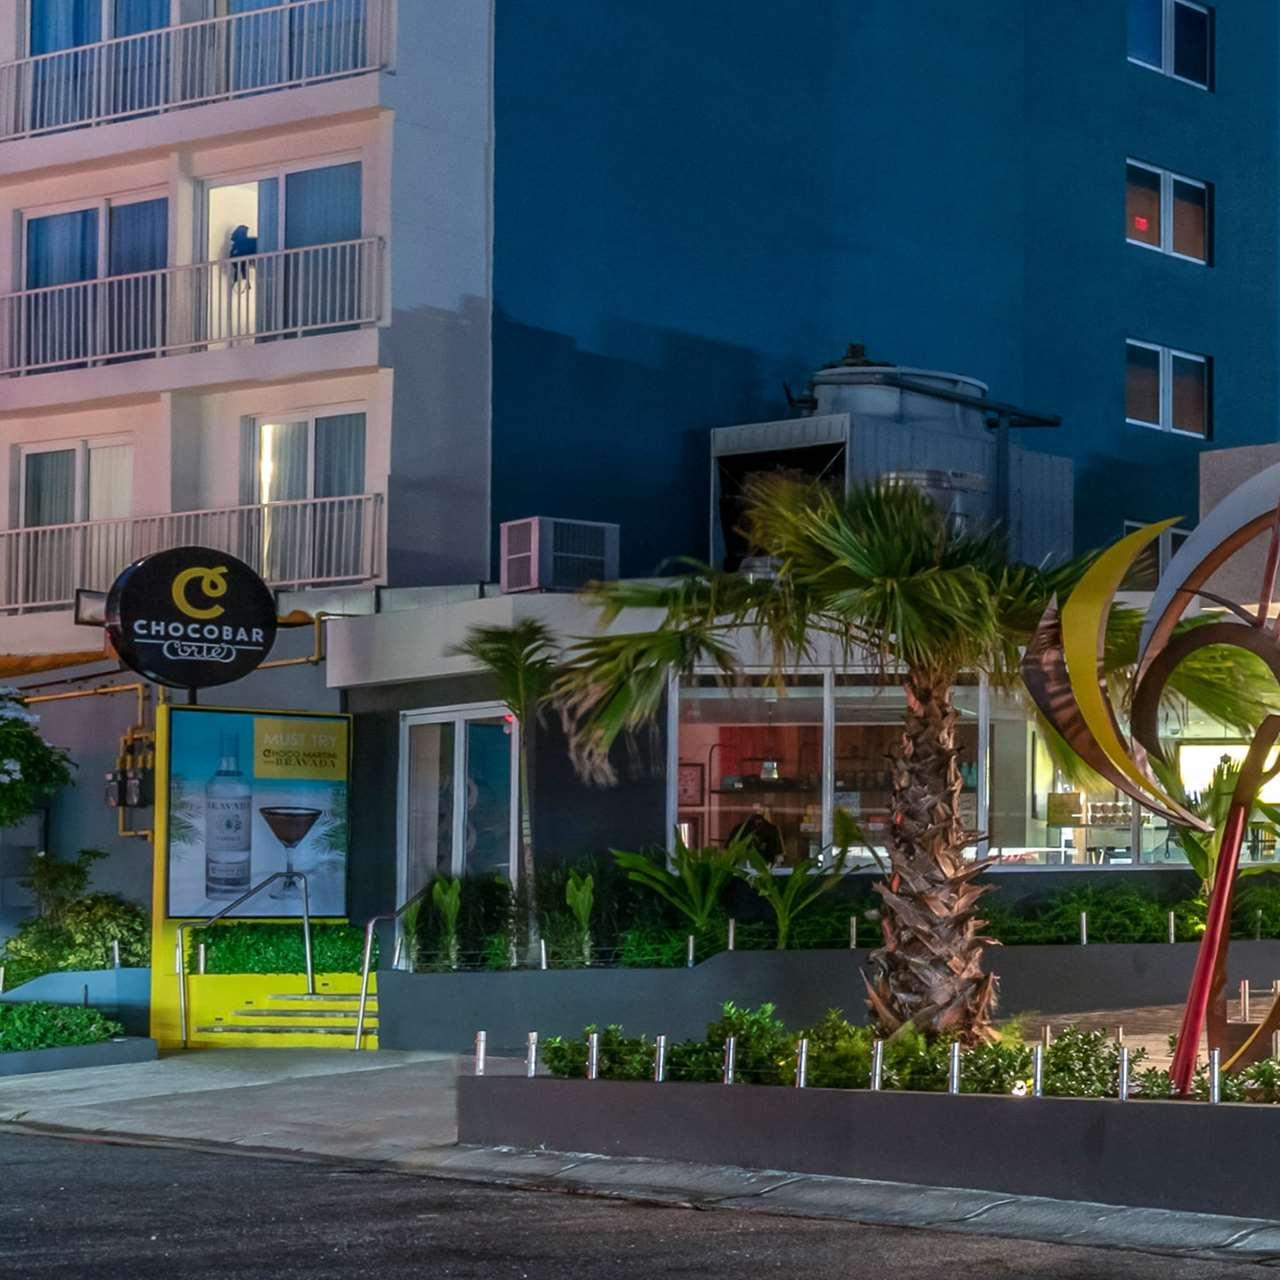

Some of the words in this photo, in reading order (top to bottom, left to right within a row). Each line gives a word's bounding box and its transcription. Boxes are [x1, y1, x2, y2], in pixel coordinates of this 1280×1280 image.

[133, 619, 265, 644] CHOCOBAR
[263, 732, 305, 747] MUST
[310, 733, 337, 750] TRY
